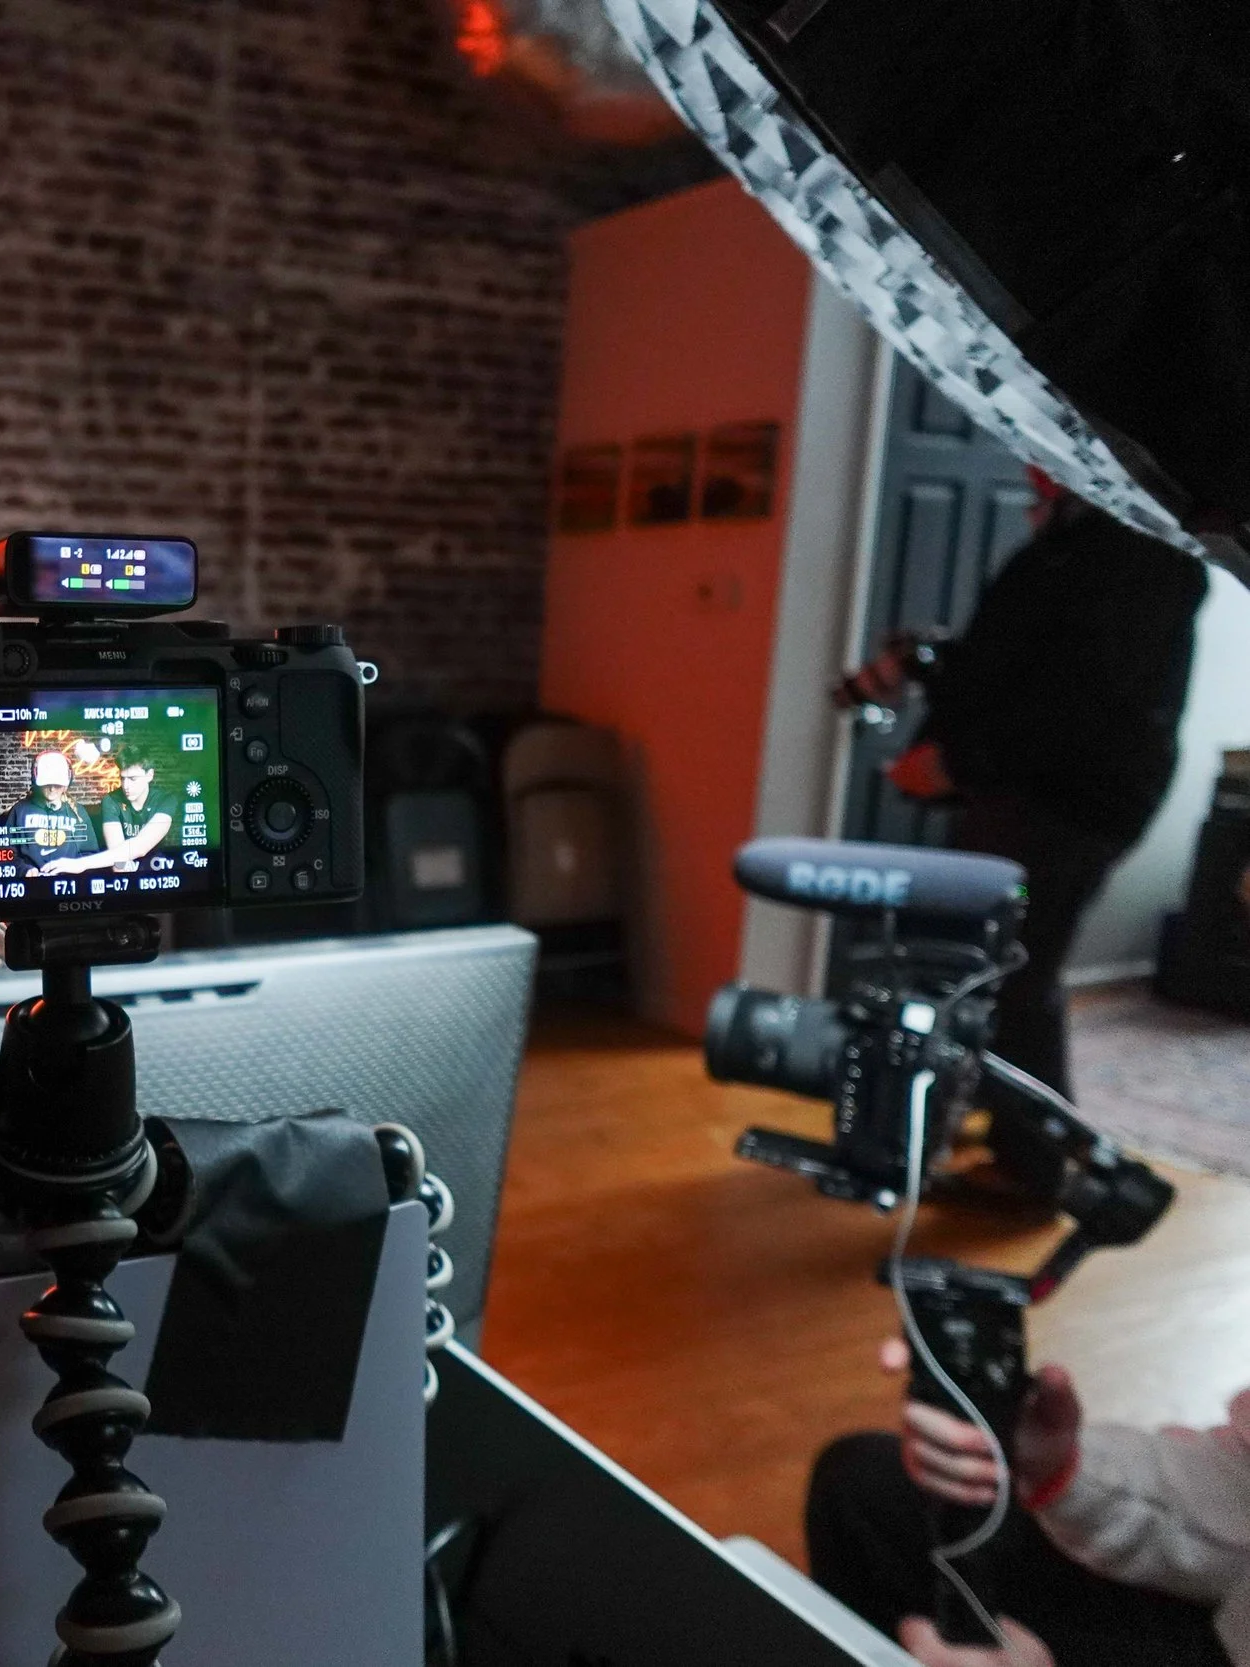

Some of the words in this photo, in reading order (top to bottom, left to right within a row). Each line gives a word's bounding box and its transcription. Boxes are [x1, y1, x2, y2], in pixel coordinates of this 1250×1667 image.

[98, 650, 127, 660] MENU
[16, 708, 32, 720] 10h
[33, 708, 48, 720] 7m
[250, 747, 263, 757] Fn
[267, 764, 289, 776] DISP
[184, 813, 205, 823] AUTO
[314, 808, 330, 820] ISO
[193, 858, 208, 868] OFF
[313, 858, 323, 870] C
[54, 880, 76, 896] F7.1
[58, 900, 103, 912] SONY
